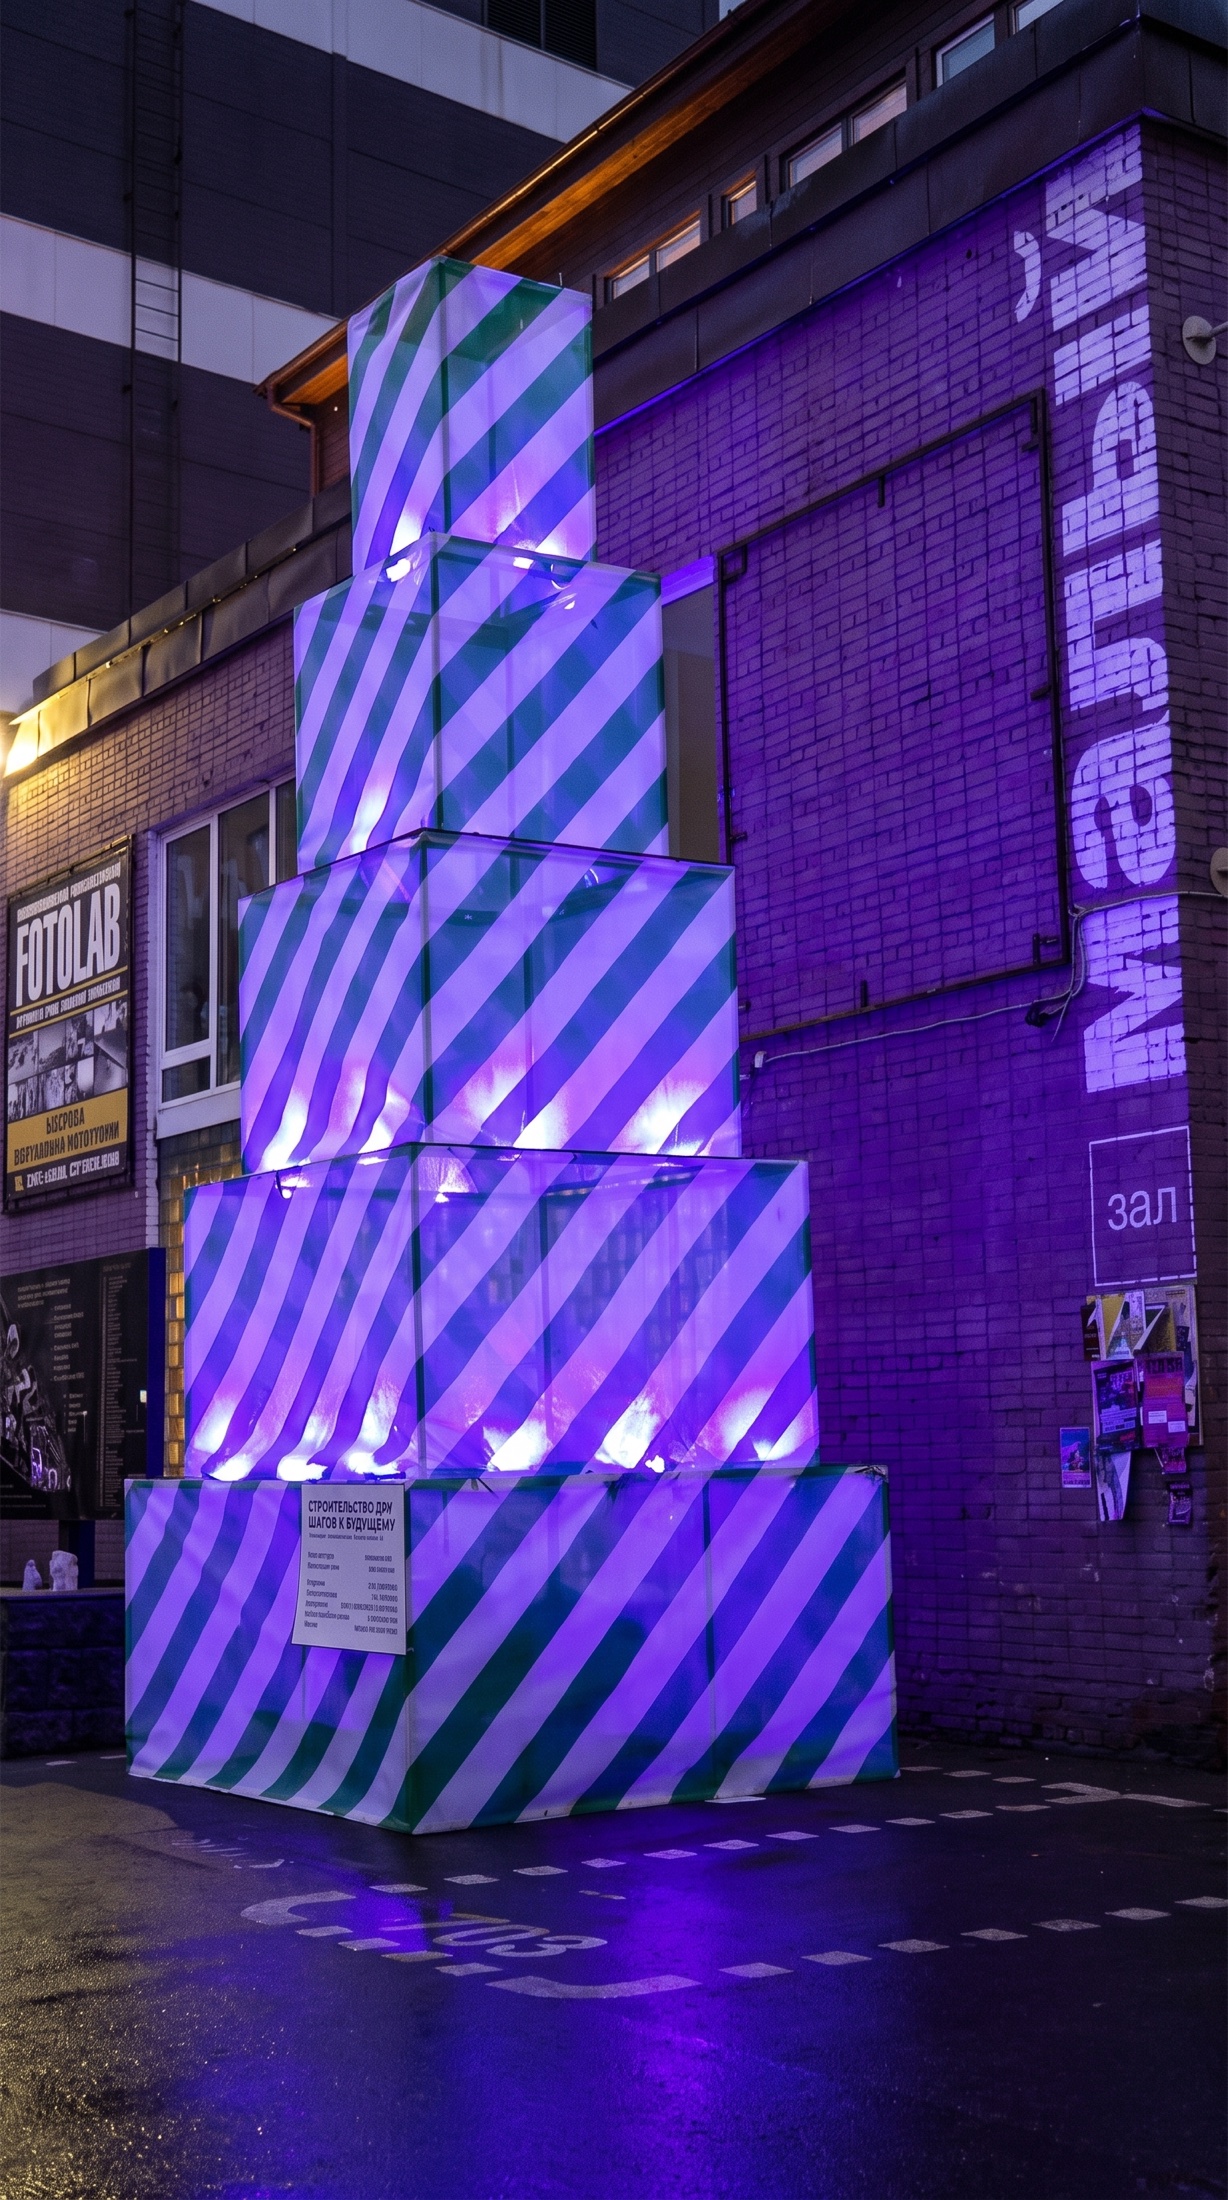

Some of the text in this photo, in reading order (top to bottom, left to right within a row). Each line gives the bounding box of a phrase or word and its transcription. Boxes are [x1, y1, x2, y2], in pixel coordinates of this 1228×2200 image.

[16, 883, 120, 1007] FOTOLAB
[1108, 1187, 1178, 1231] зал
[308, 1500, 374, 1514] СТРОИТЕЛЬСТВО
[308, 1516, 396, 1534] ШАГОВ К БУДУЩЕМУ
